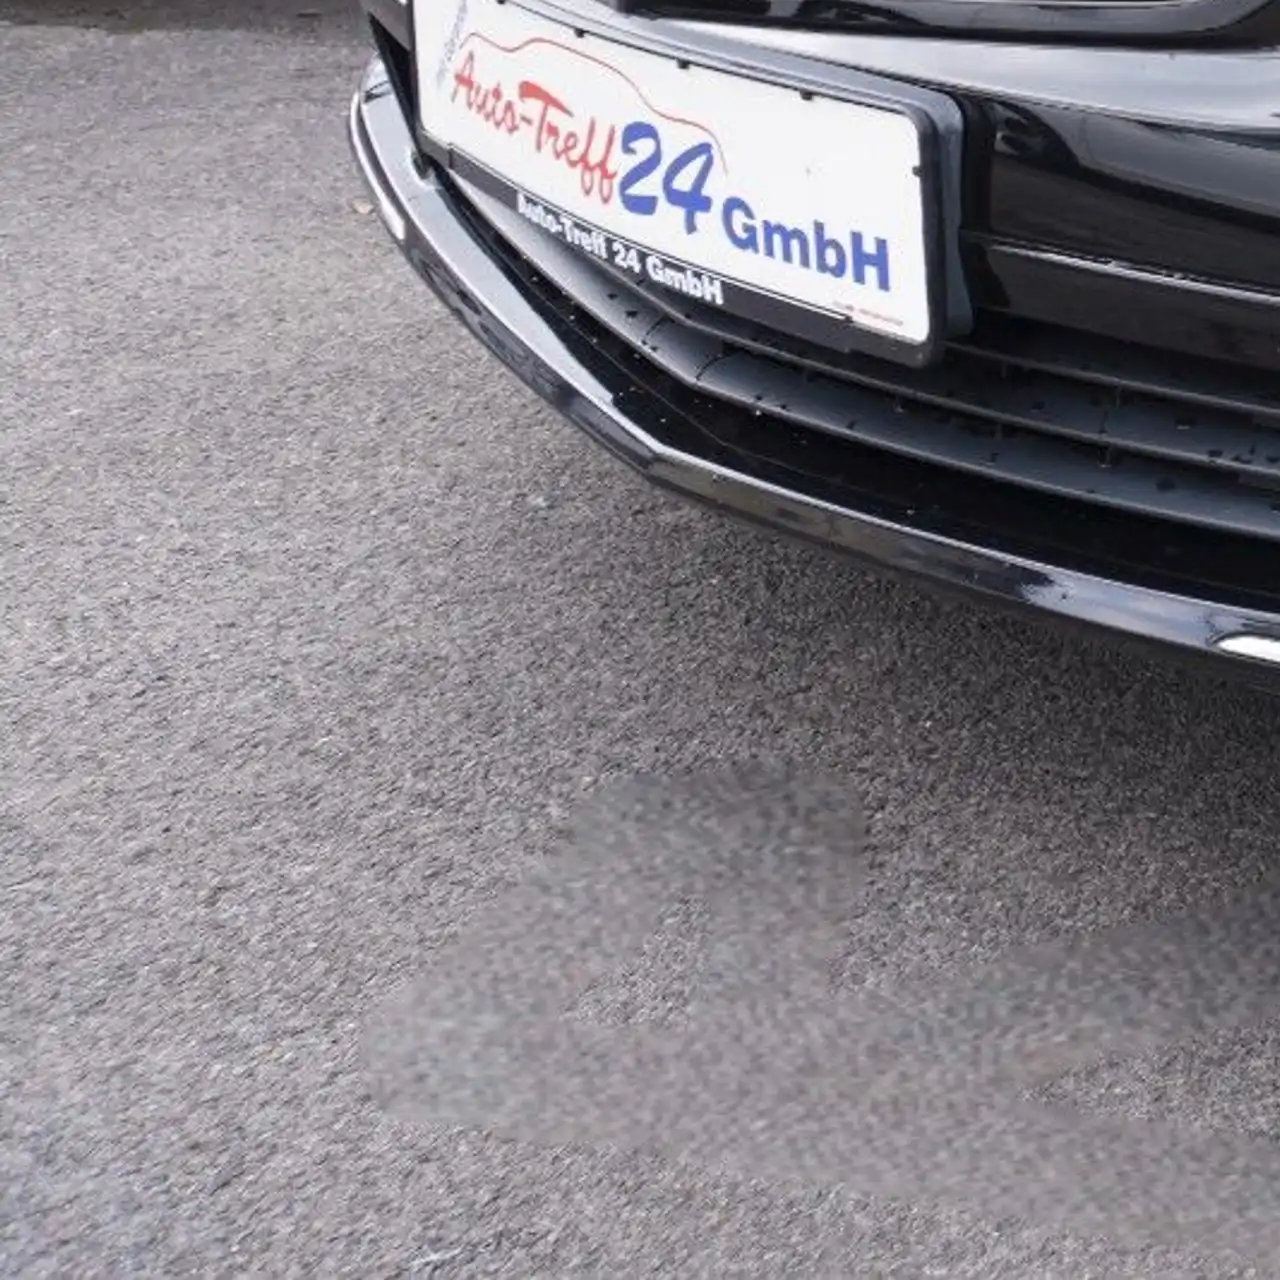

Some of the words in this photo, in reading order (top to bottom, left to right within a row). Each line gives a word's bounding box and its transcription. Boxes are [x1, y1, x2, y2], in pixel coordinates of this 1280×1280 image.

[516, 191, 608, 260] Auto-Treff
[612, 242, 641, 273] 24
[646, 255, 724, 305] GmbH
[722, 196, 890, 293] GmbH
